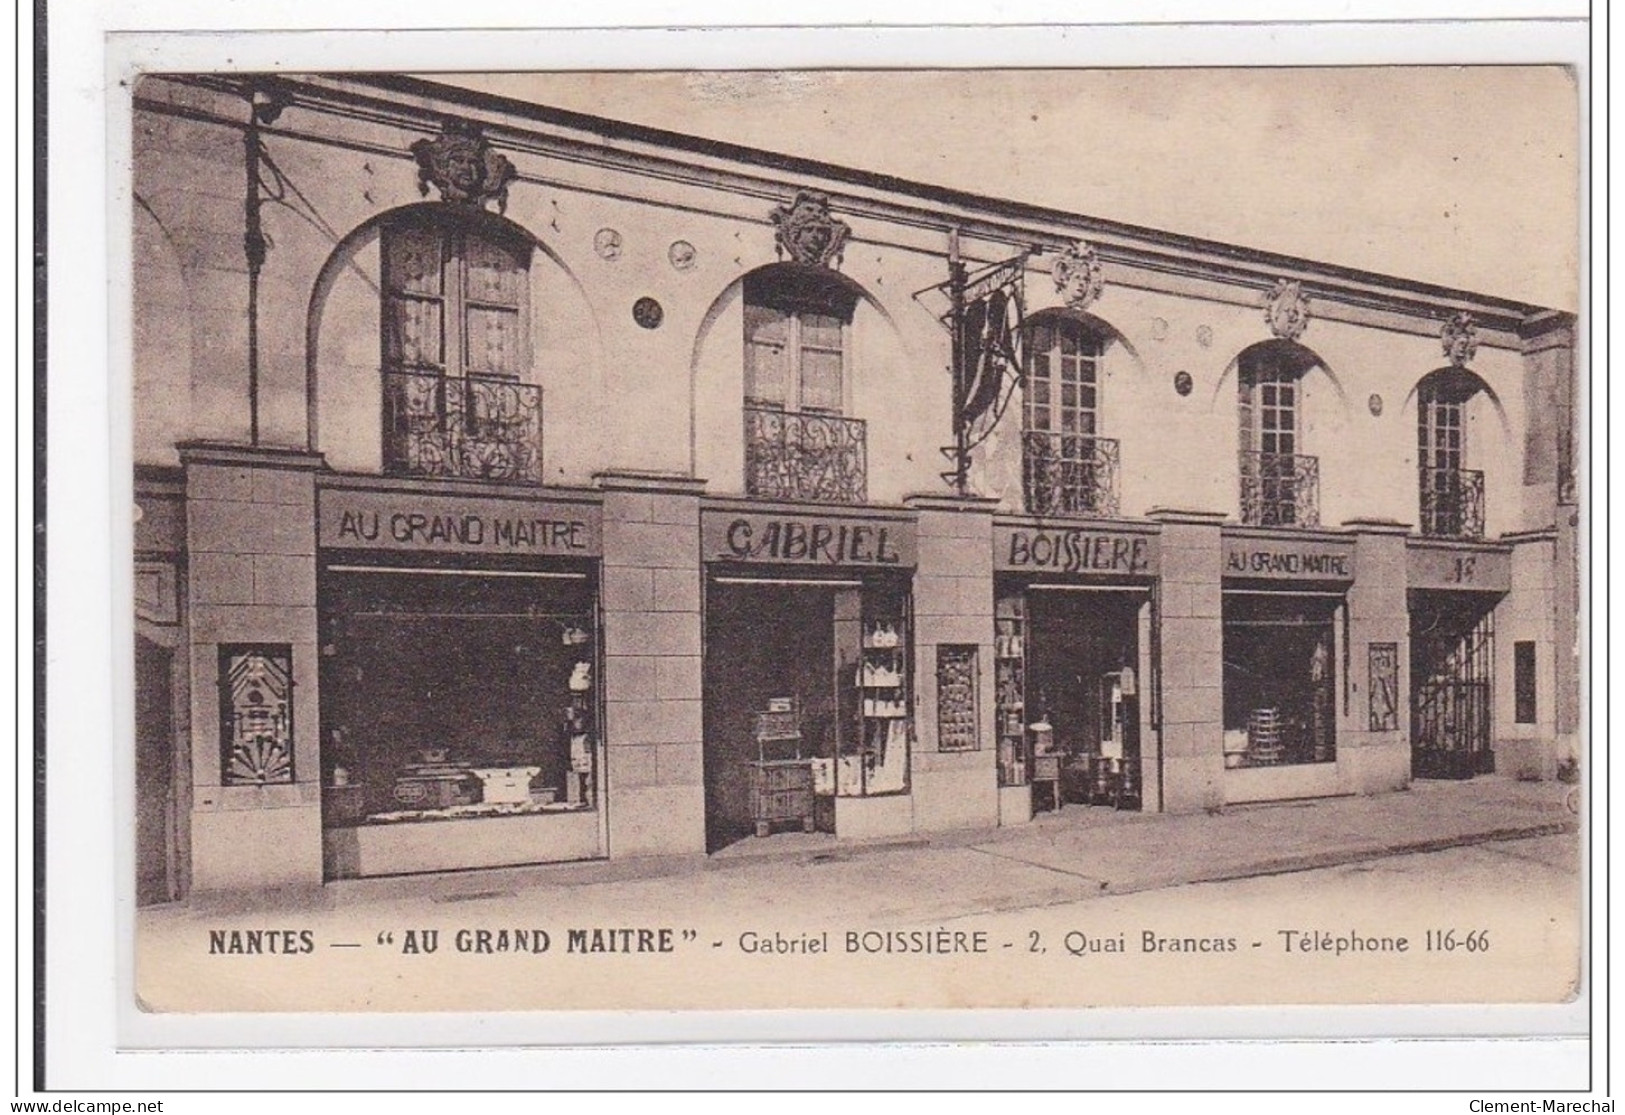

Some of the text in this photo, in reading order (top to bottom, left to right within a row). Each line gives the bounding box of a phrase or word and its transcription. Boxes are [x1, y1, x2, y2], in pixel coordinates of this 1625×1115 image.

[338, 510, 586, 549] AU GRAND MAITRE
[718, 518, 900, 564] GABRIEL
[1008, 529, 1149, 572] BOISSIERE
[1226, 552, 1349, 576] AU GRAND MAITRE
